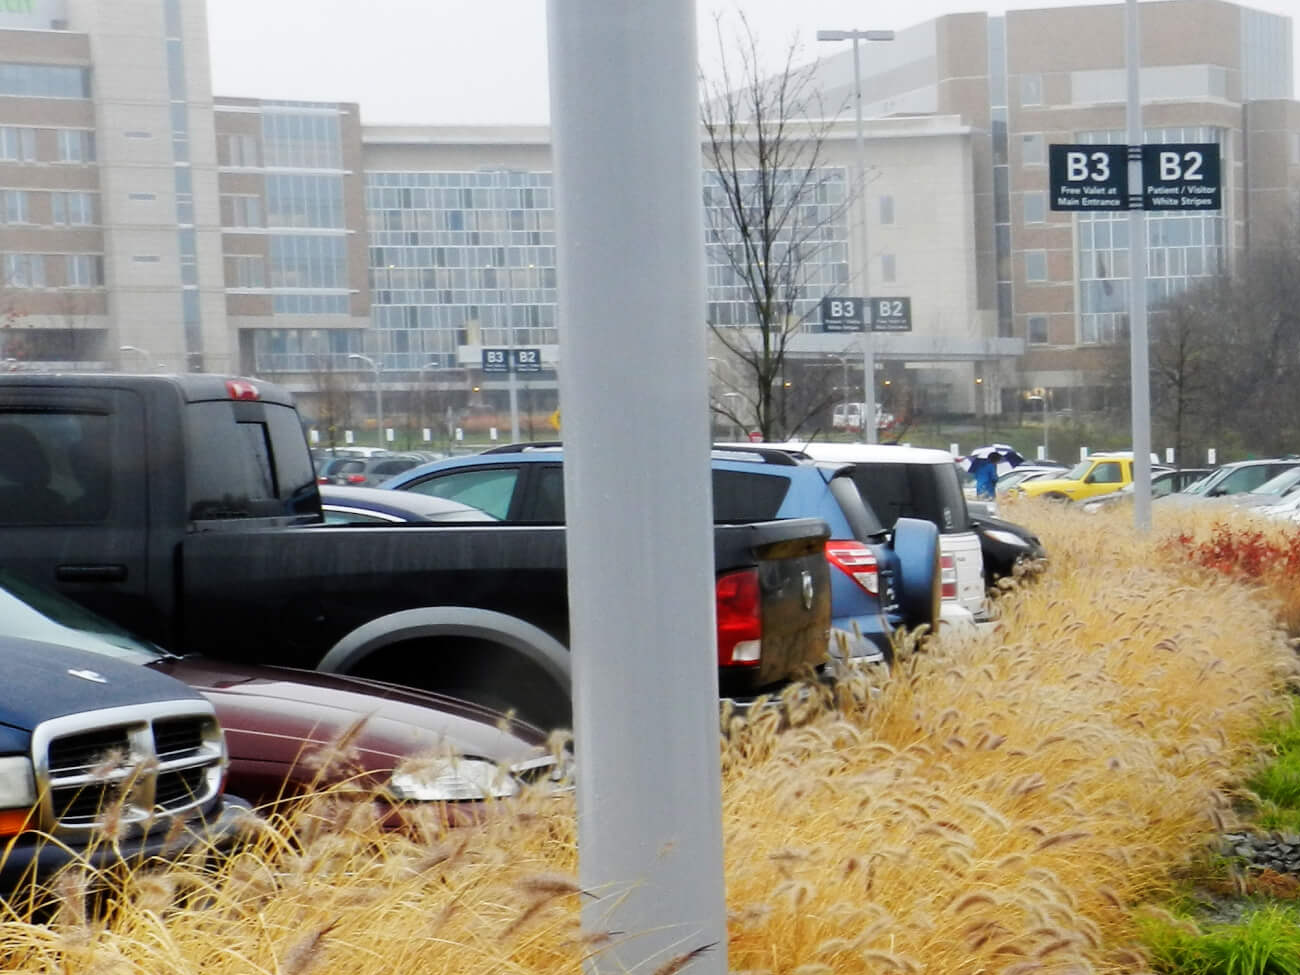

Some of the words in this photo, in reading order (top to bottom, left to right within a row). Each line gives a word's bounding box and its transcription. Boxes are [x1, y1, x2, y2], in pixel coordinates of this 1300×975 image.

[1067, 152, 1110, 182] B3
[1160, 151, 1203, 181] B2
[1061, 186, 1081, 194] Free
[1083, 186, 1105, 194] Valet
[1147, 186, 1179, 194] Patient
[1188, 186, 1217, 194] Visitor
[1058, 197, 1079, 206] Main
[1082, 197, 1120, 206] Entrance
[1152, 197, 1178, 206] White
[1181, 197, 1212, 207] Stripes
[831, 301, 854, 317] B3
[880, 301, 903, 317] B2
[487, 351, 503, 363] B3
[520, 351, 536, 363] B2
